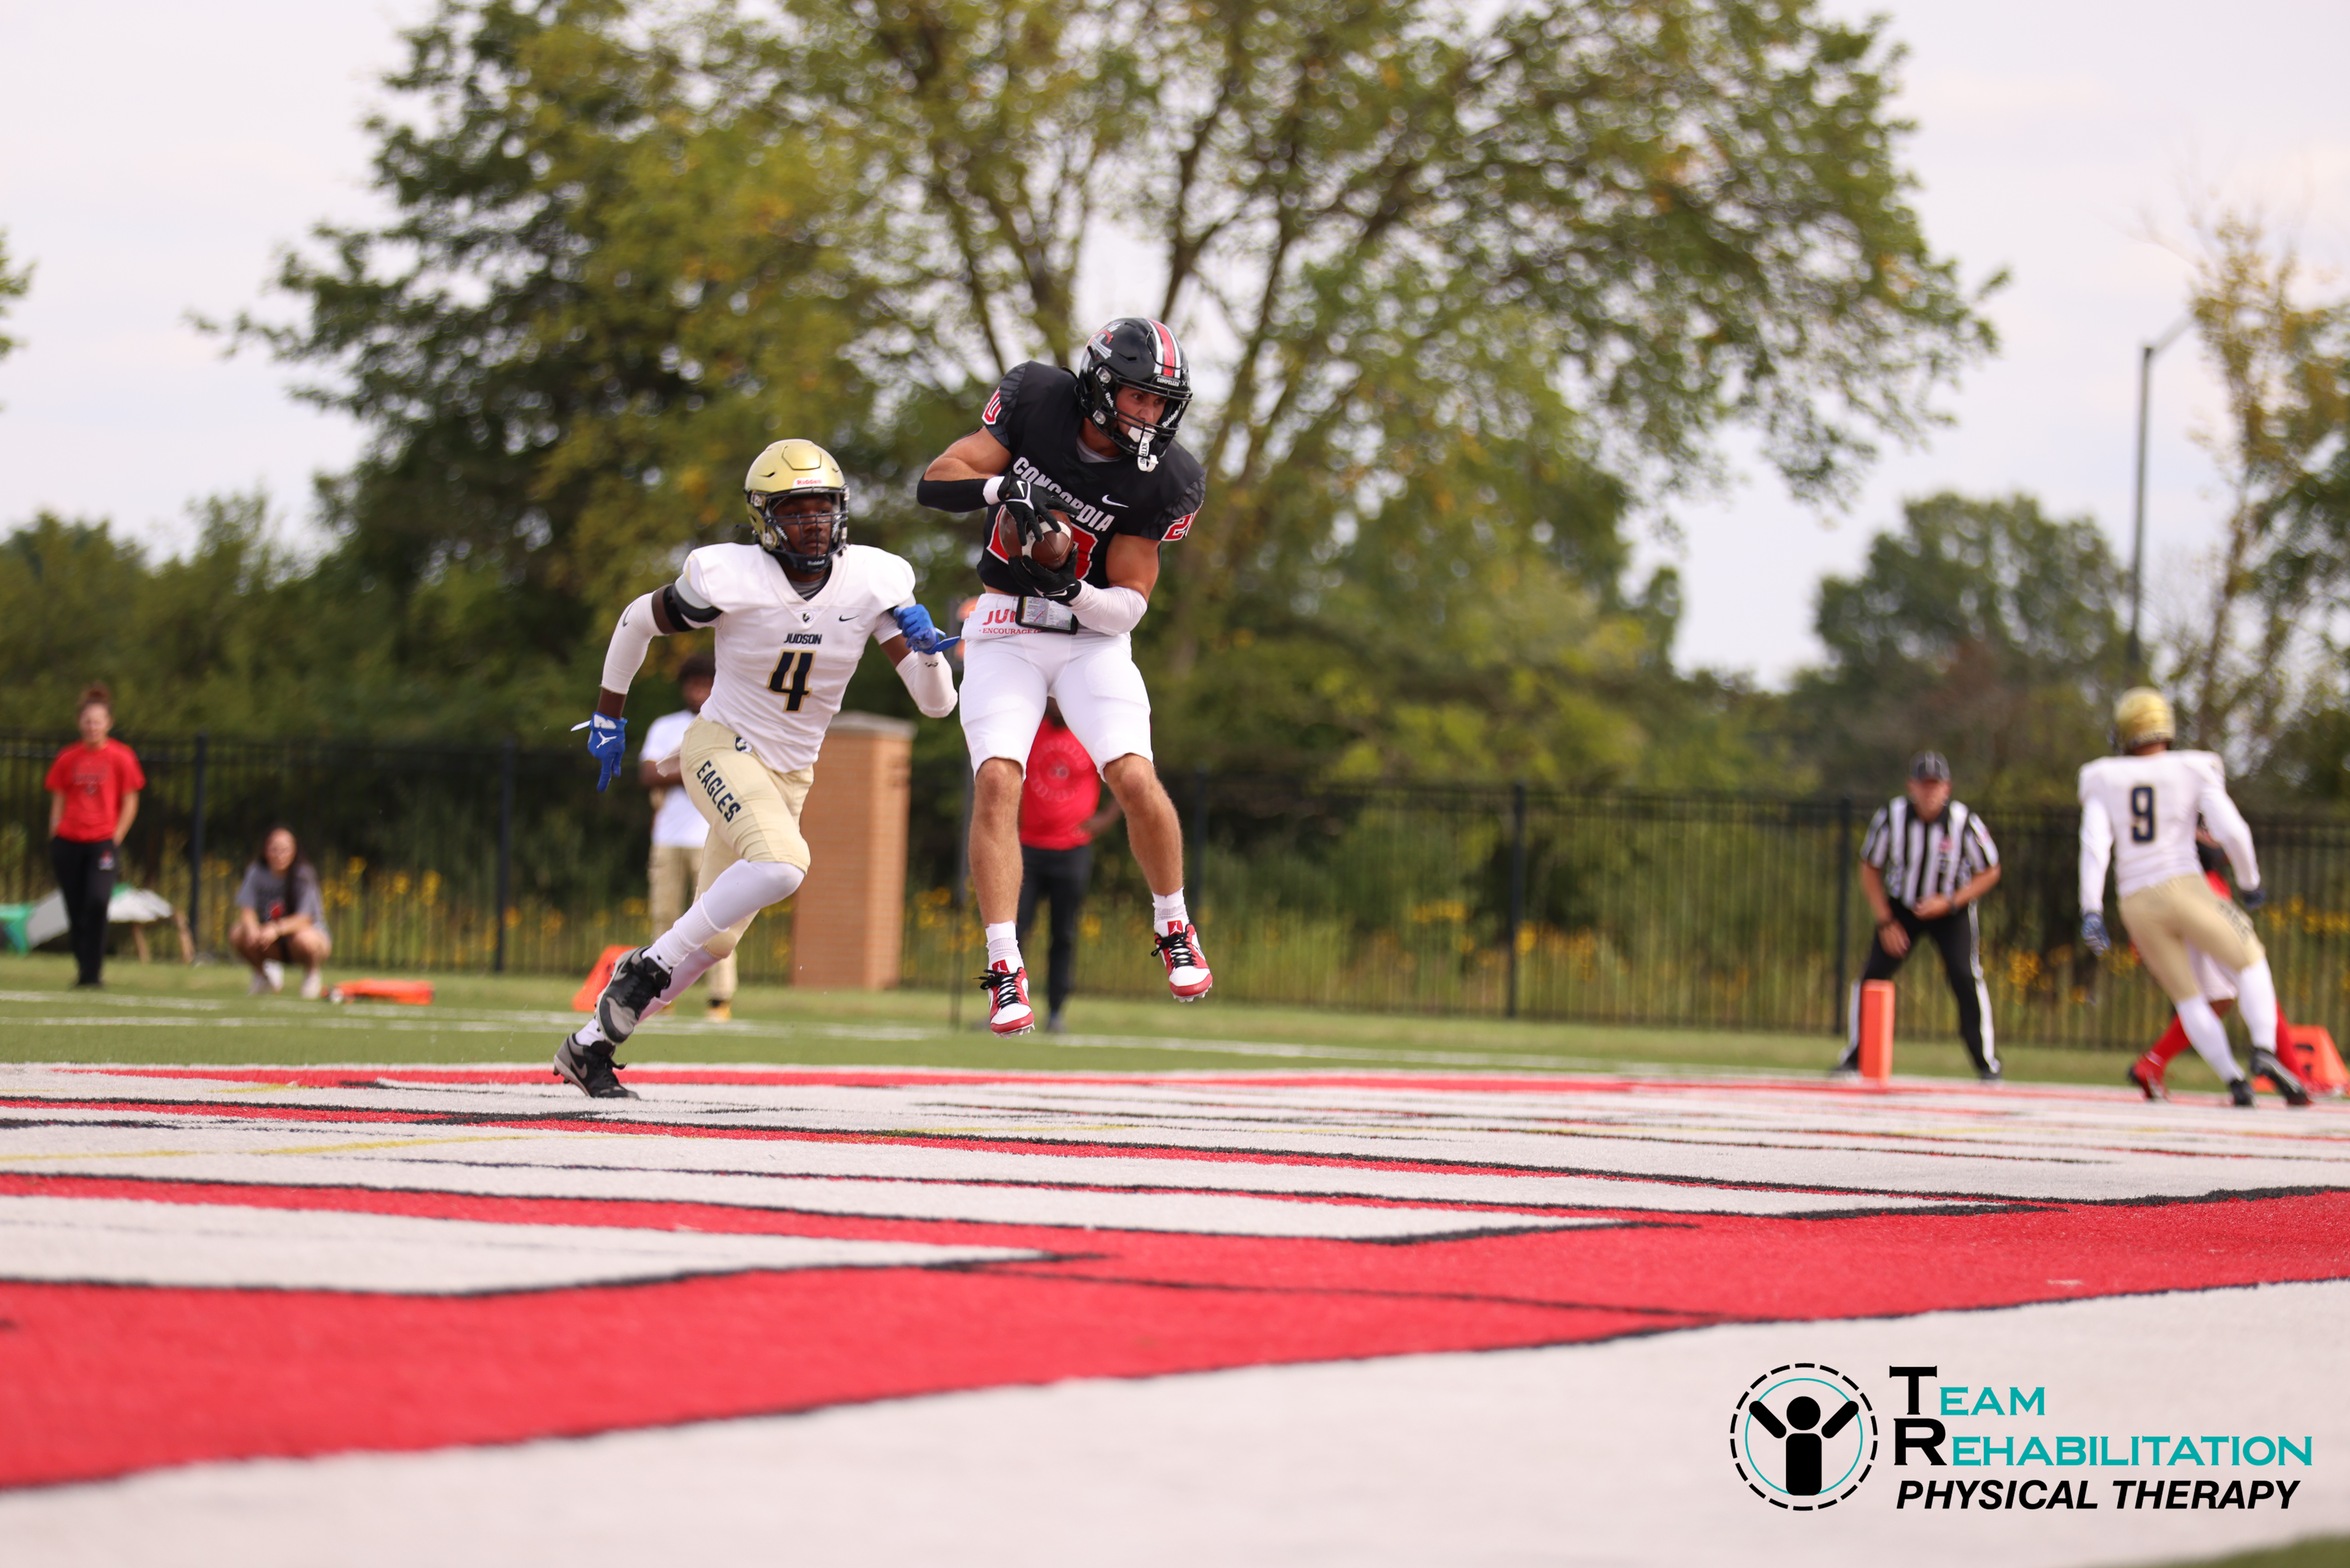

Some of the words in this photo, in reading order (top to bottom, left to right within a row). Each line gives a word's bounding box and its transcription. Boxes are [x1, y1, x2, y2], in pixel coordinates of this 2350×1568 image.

[784, 633, 823, 645] JUDSON
[767, 649, 817, 714] 4
[696, 760, 742, 823] EAGLES
[2130, 785, 2156, 844] 9
